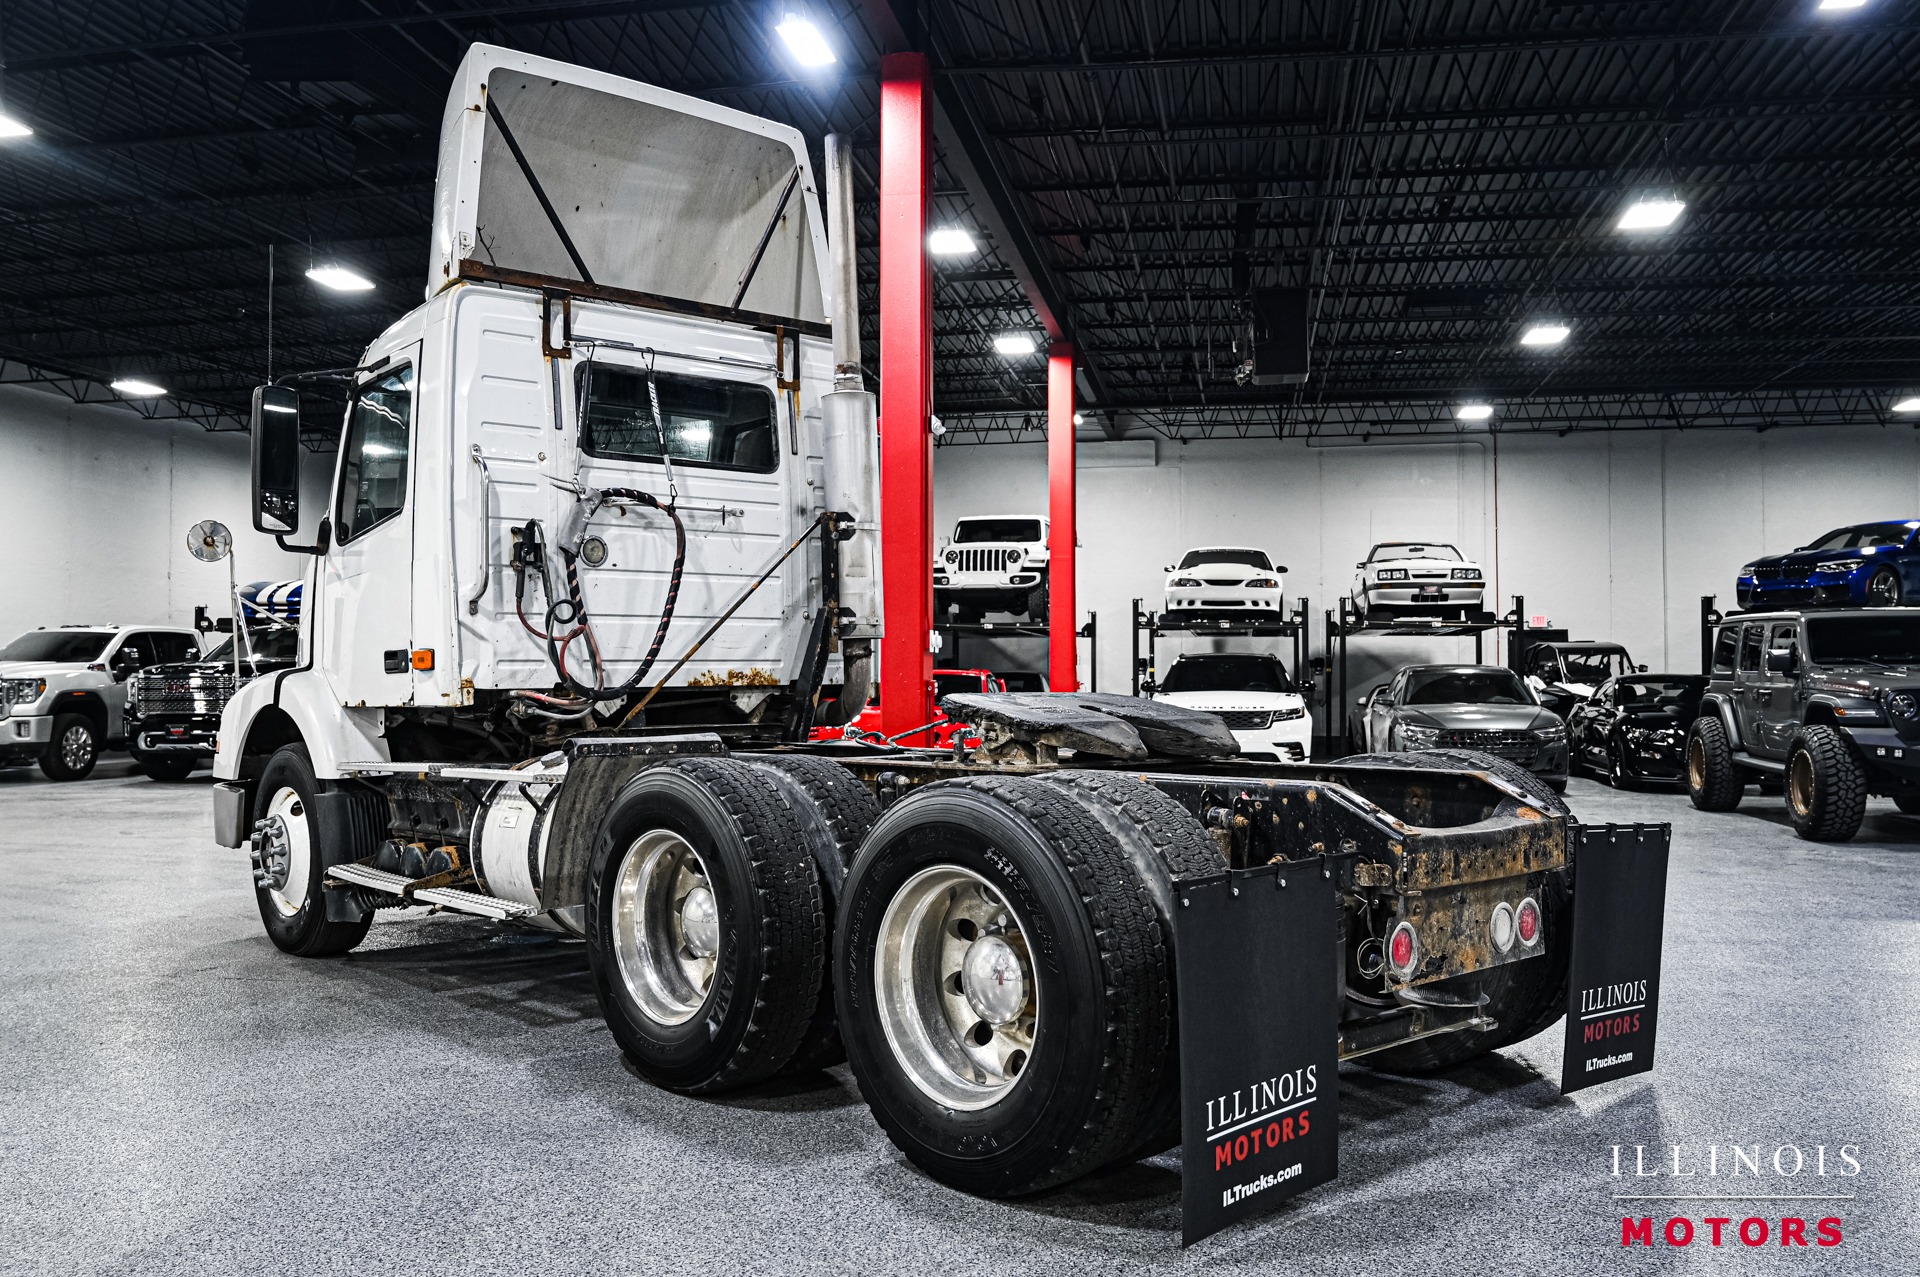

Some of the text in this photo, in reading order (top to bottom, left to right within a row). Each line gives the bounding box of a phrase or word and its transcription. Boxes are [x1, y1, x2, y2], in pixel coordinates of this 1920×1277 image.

[1532, 616, 1545, 625] EXIT
[1581, 979, 1647, 1012] ILLINOIS
[1583, 1013, 1640, 1044] MOTORS
[1585, 1052, 1633, 1072] ILTrucks.com
[1206, 1064, 1317, 1131] ILLINOIS
[1215, 1110, 1310, 1171] MOTORS
[1223, 1163, 1302, 1207] ILTrucks.com
